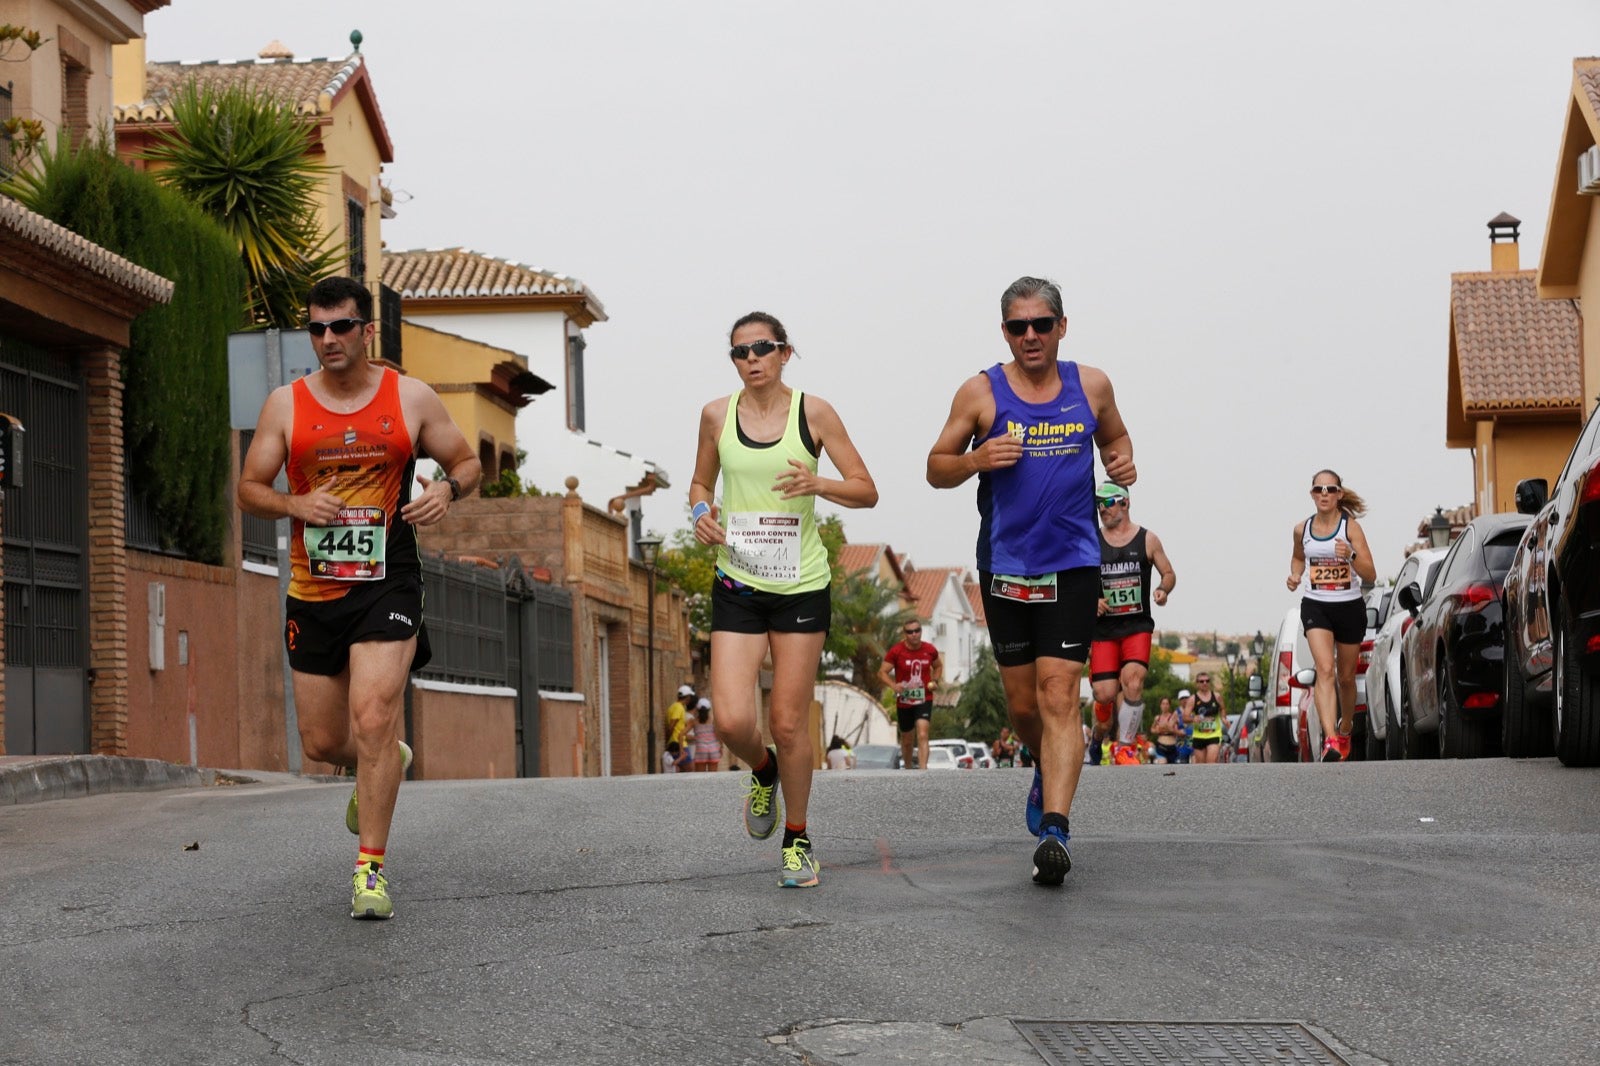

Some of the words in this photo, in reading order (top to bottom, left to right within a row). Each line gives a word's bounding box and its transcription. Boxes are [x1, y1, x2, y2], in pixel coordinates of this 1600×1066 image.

[1028, 422, 1084, 437] olimpo
[1027, 437, 1063, 446] deportes
[338, 509, 359, 518] PREMIO
[358, 509, 366, 517] DE
[317, 530, 374, 556] 445
[1101, 561, 1141, 574] GRANADA
[1315, 567, 1349, 580] 2292
[1110, 588, 1136, 604] 151
